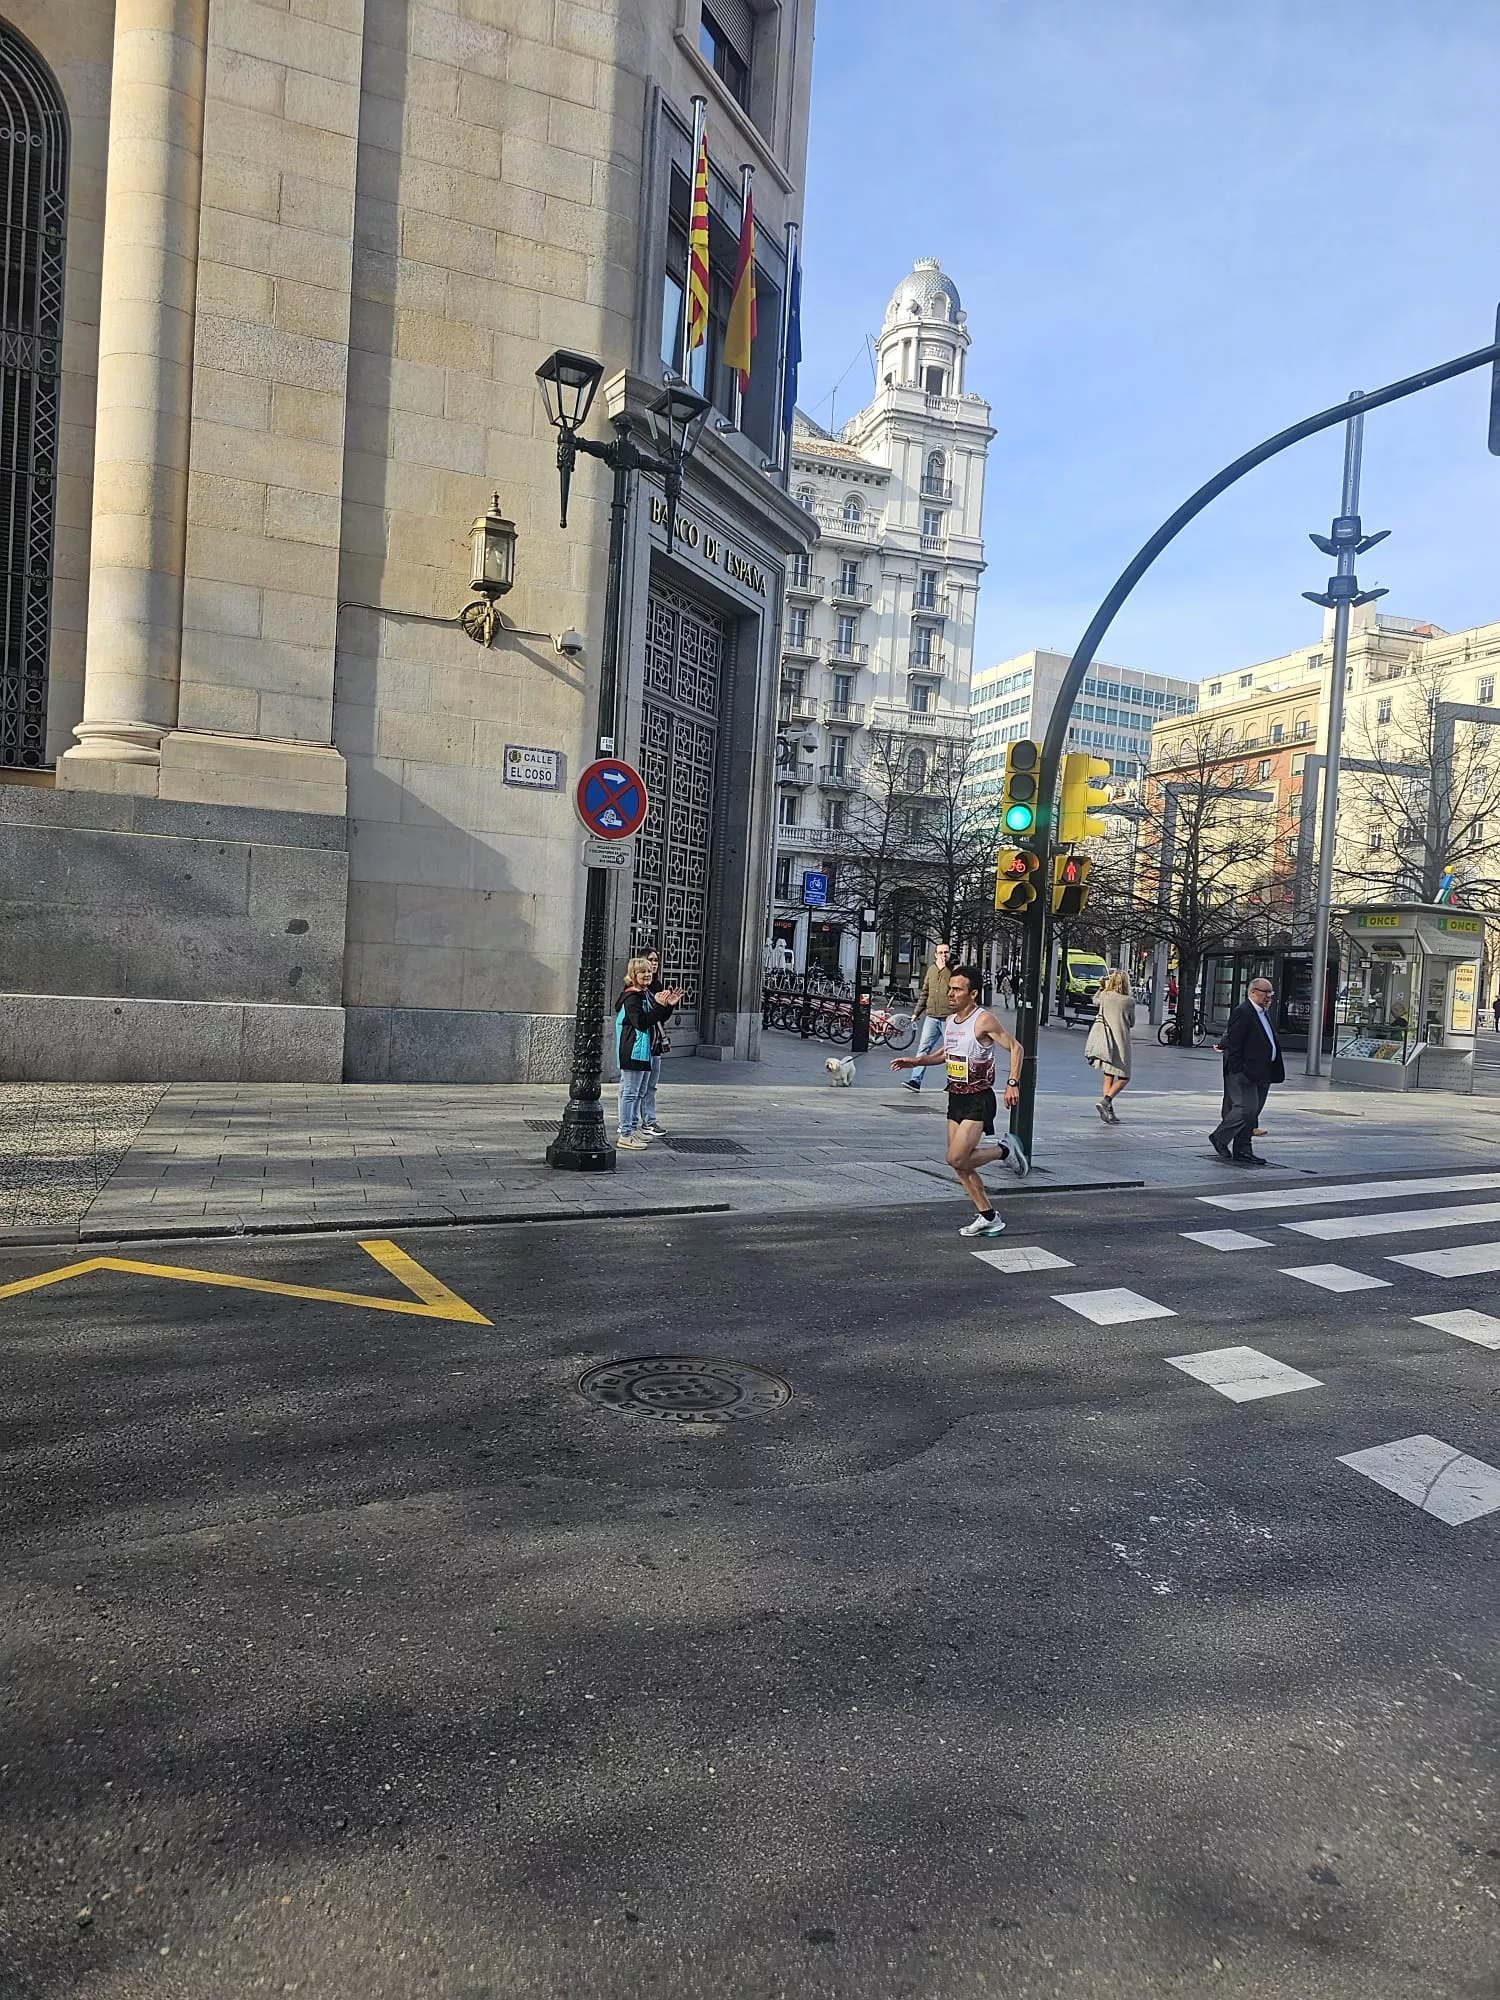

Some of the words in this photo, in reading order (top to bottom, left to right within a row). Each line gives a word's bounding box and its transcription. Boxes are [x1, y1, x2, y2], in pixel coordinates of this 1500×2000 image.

[651, 496, 699, 548] BANCO
[705, 534, 721, 565] DE
[727, 549, 767, 597] ESPAÑA
[524, 753, 553, 765] CALLE
[511, 766, 522, 778] EL
[525, 768, 552, 781] COSO
[1369, 916, 1397, 926] ONCE
[1450, 920, 1478, 932] ONCE
[591, 1362, 747, 1390] Telefónica
